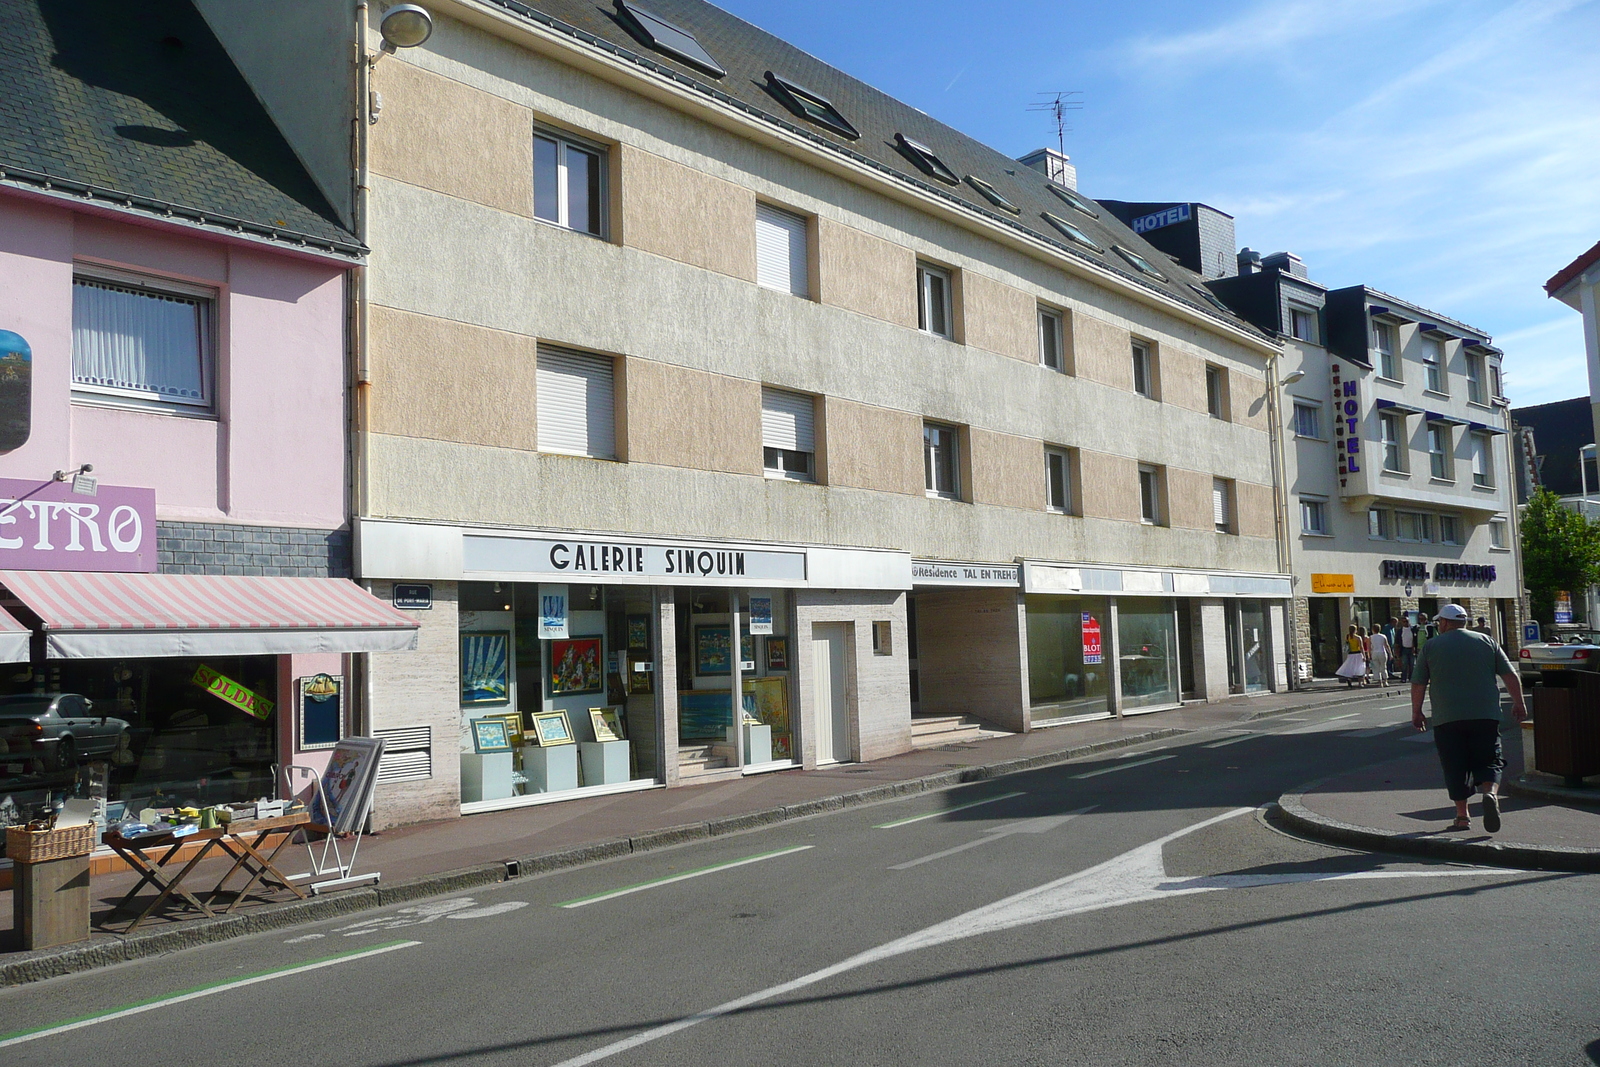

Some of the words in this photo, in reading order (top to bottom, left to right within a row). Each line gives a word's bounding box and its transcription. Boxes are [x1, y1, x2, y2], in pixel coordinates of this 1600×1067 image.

[1133, 206, 1188, 234] HOTEL
[1332, 364, 1347, 487] RESTAURANT
[1343, 380, 1360, 472] HOTEL
[550, 543, 643, 573] GALERIE
[665, 549, 745, 577] SINQUIN
[1435, 562, 1497, 581] ALBATROS
[963, 569, 977, 579] TAL
[981, 569, 991, 580] EN
[993, 570, 1012, 580] TREH
[1527, 628, 1534, 638] P
[1083, 644, 1101, 652] BLOT
[195, 668, 271, 717] SOLDES
